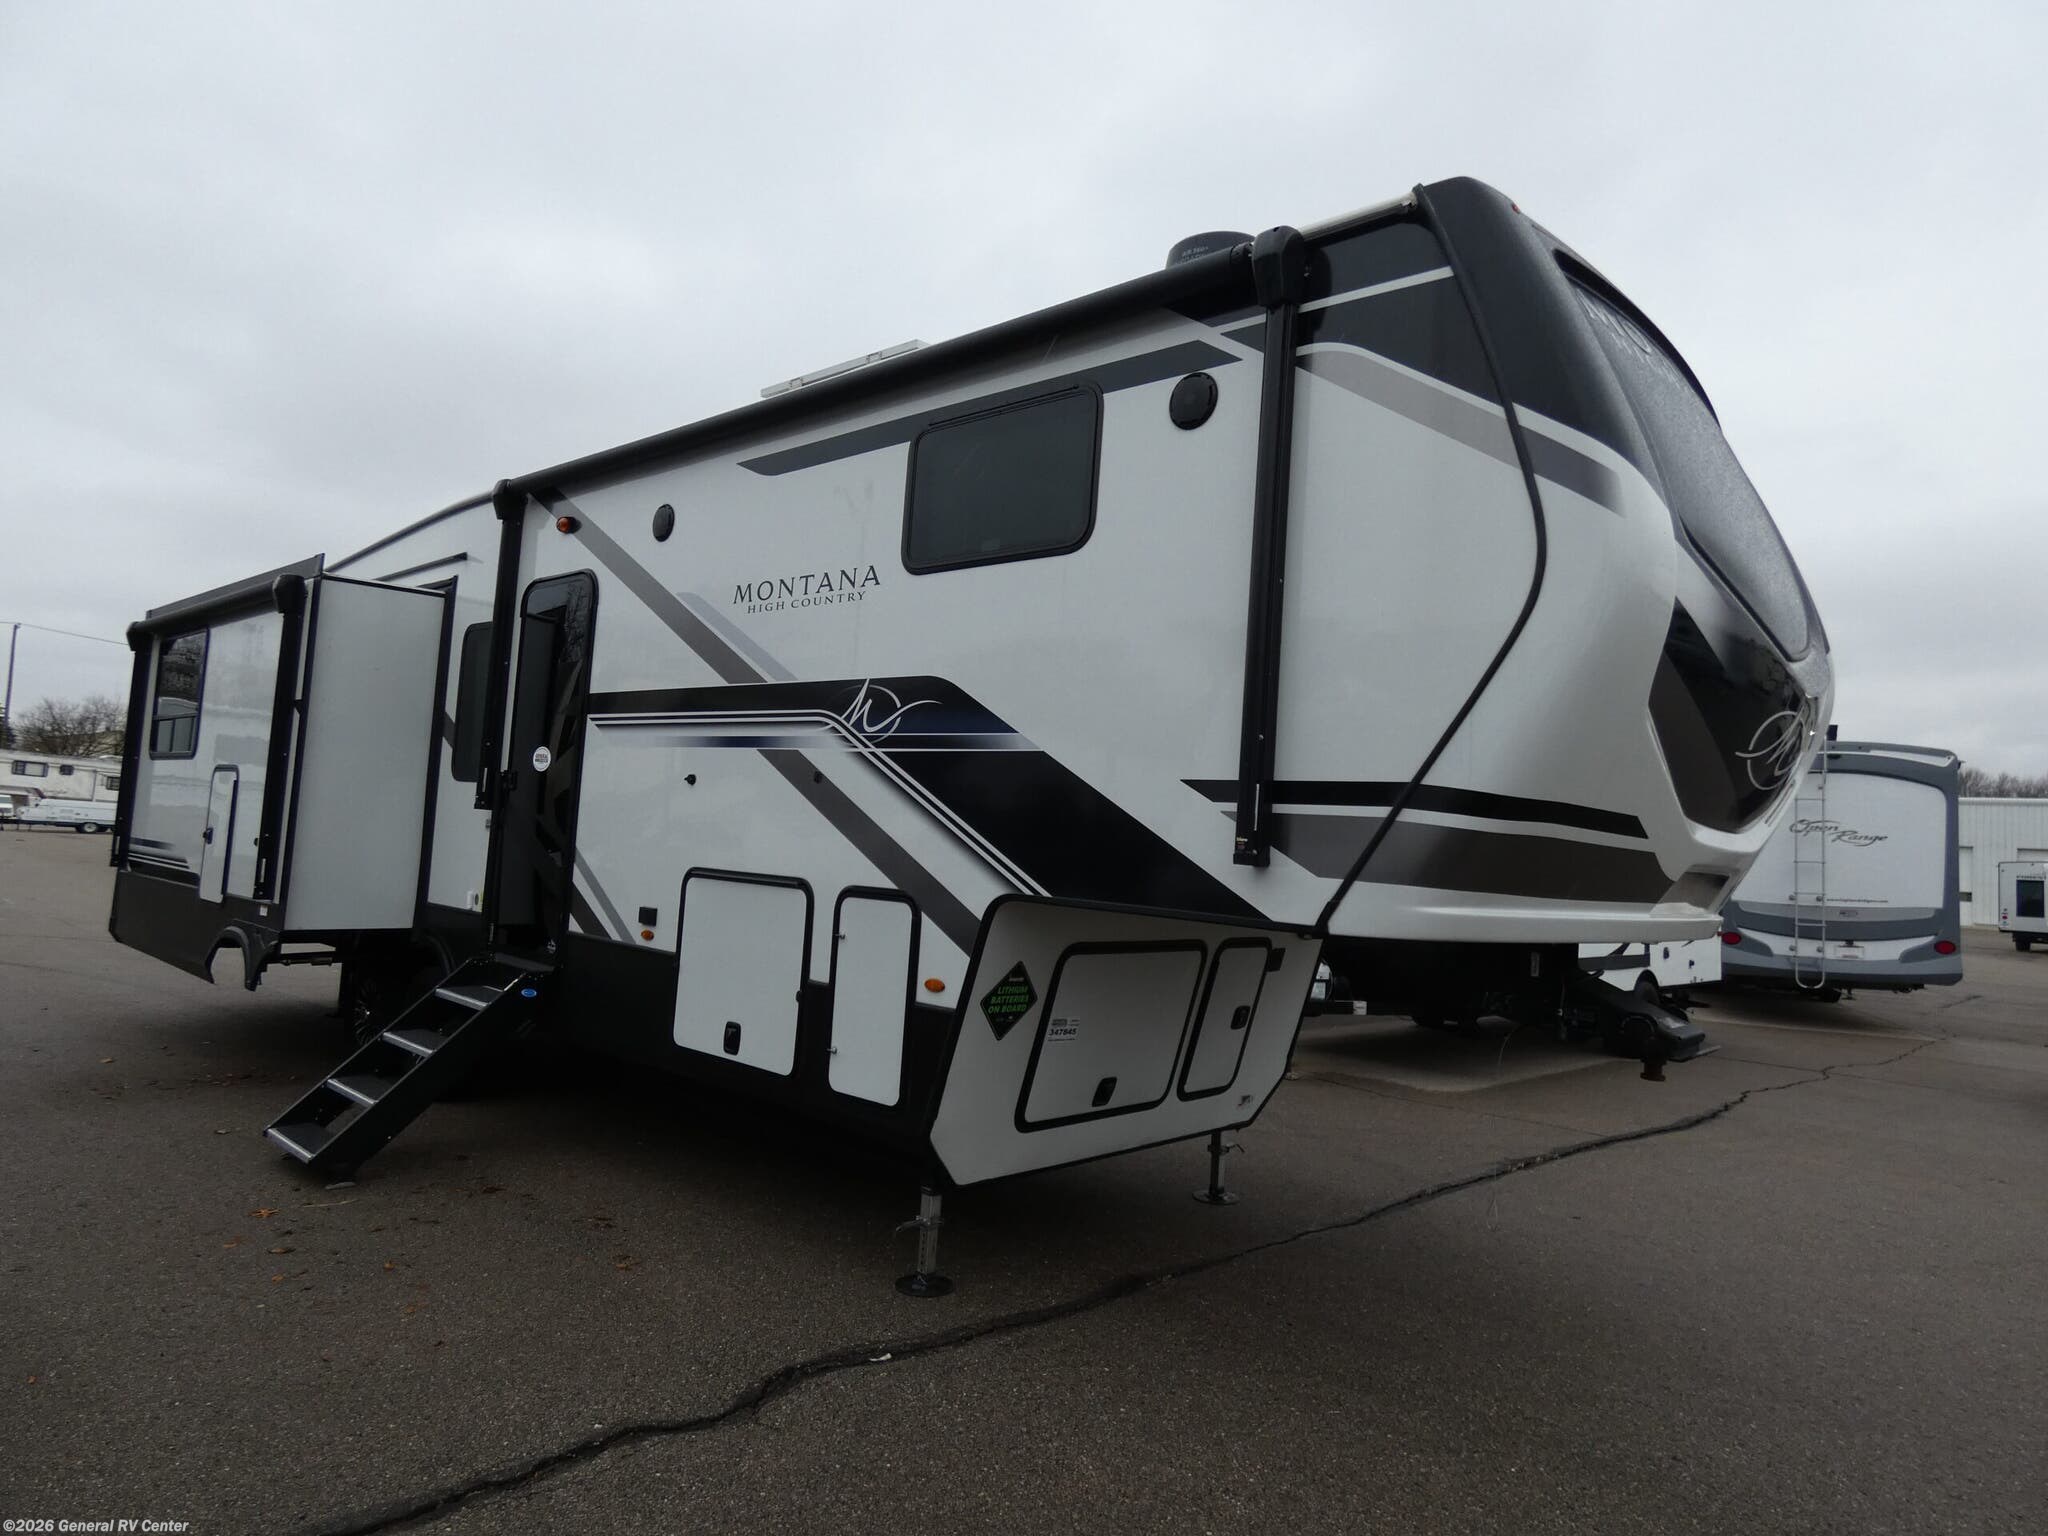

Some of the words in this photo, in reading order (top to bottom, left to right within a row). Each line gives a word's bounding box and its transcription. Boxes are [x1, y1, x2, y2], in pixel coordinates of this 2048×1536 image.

[733, 564, 881, 604] MONTANA
[747, 601, 785, 614] HIGH
[791, 590, 866, 609] COUNTRY
[1789, 819, 1841, 836] Open
[1828, 830, 1888, 847] Range
[997, 985, 1028, 995] LITHIUM
[987, 1005, 1001, 1014] ON
[1002, 1004, 1027, 1013] BOARD
